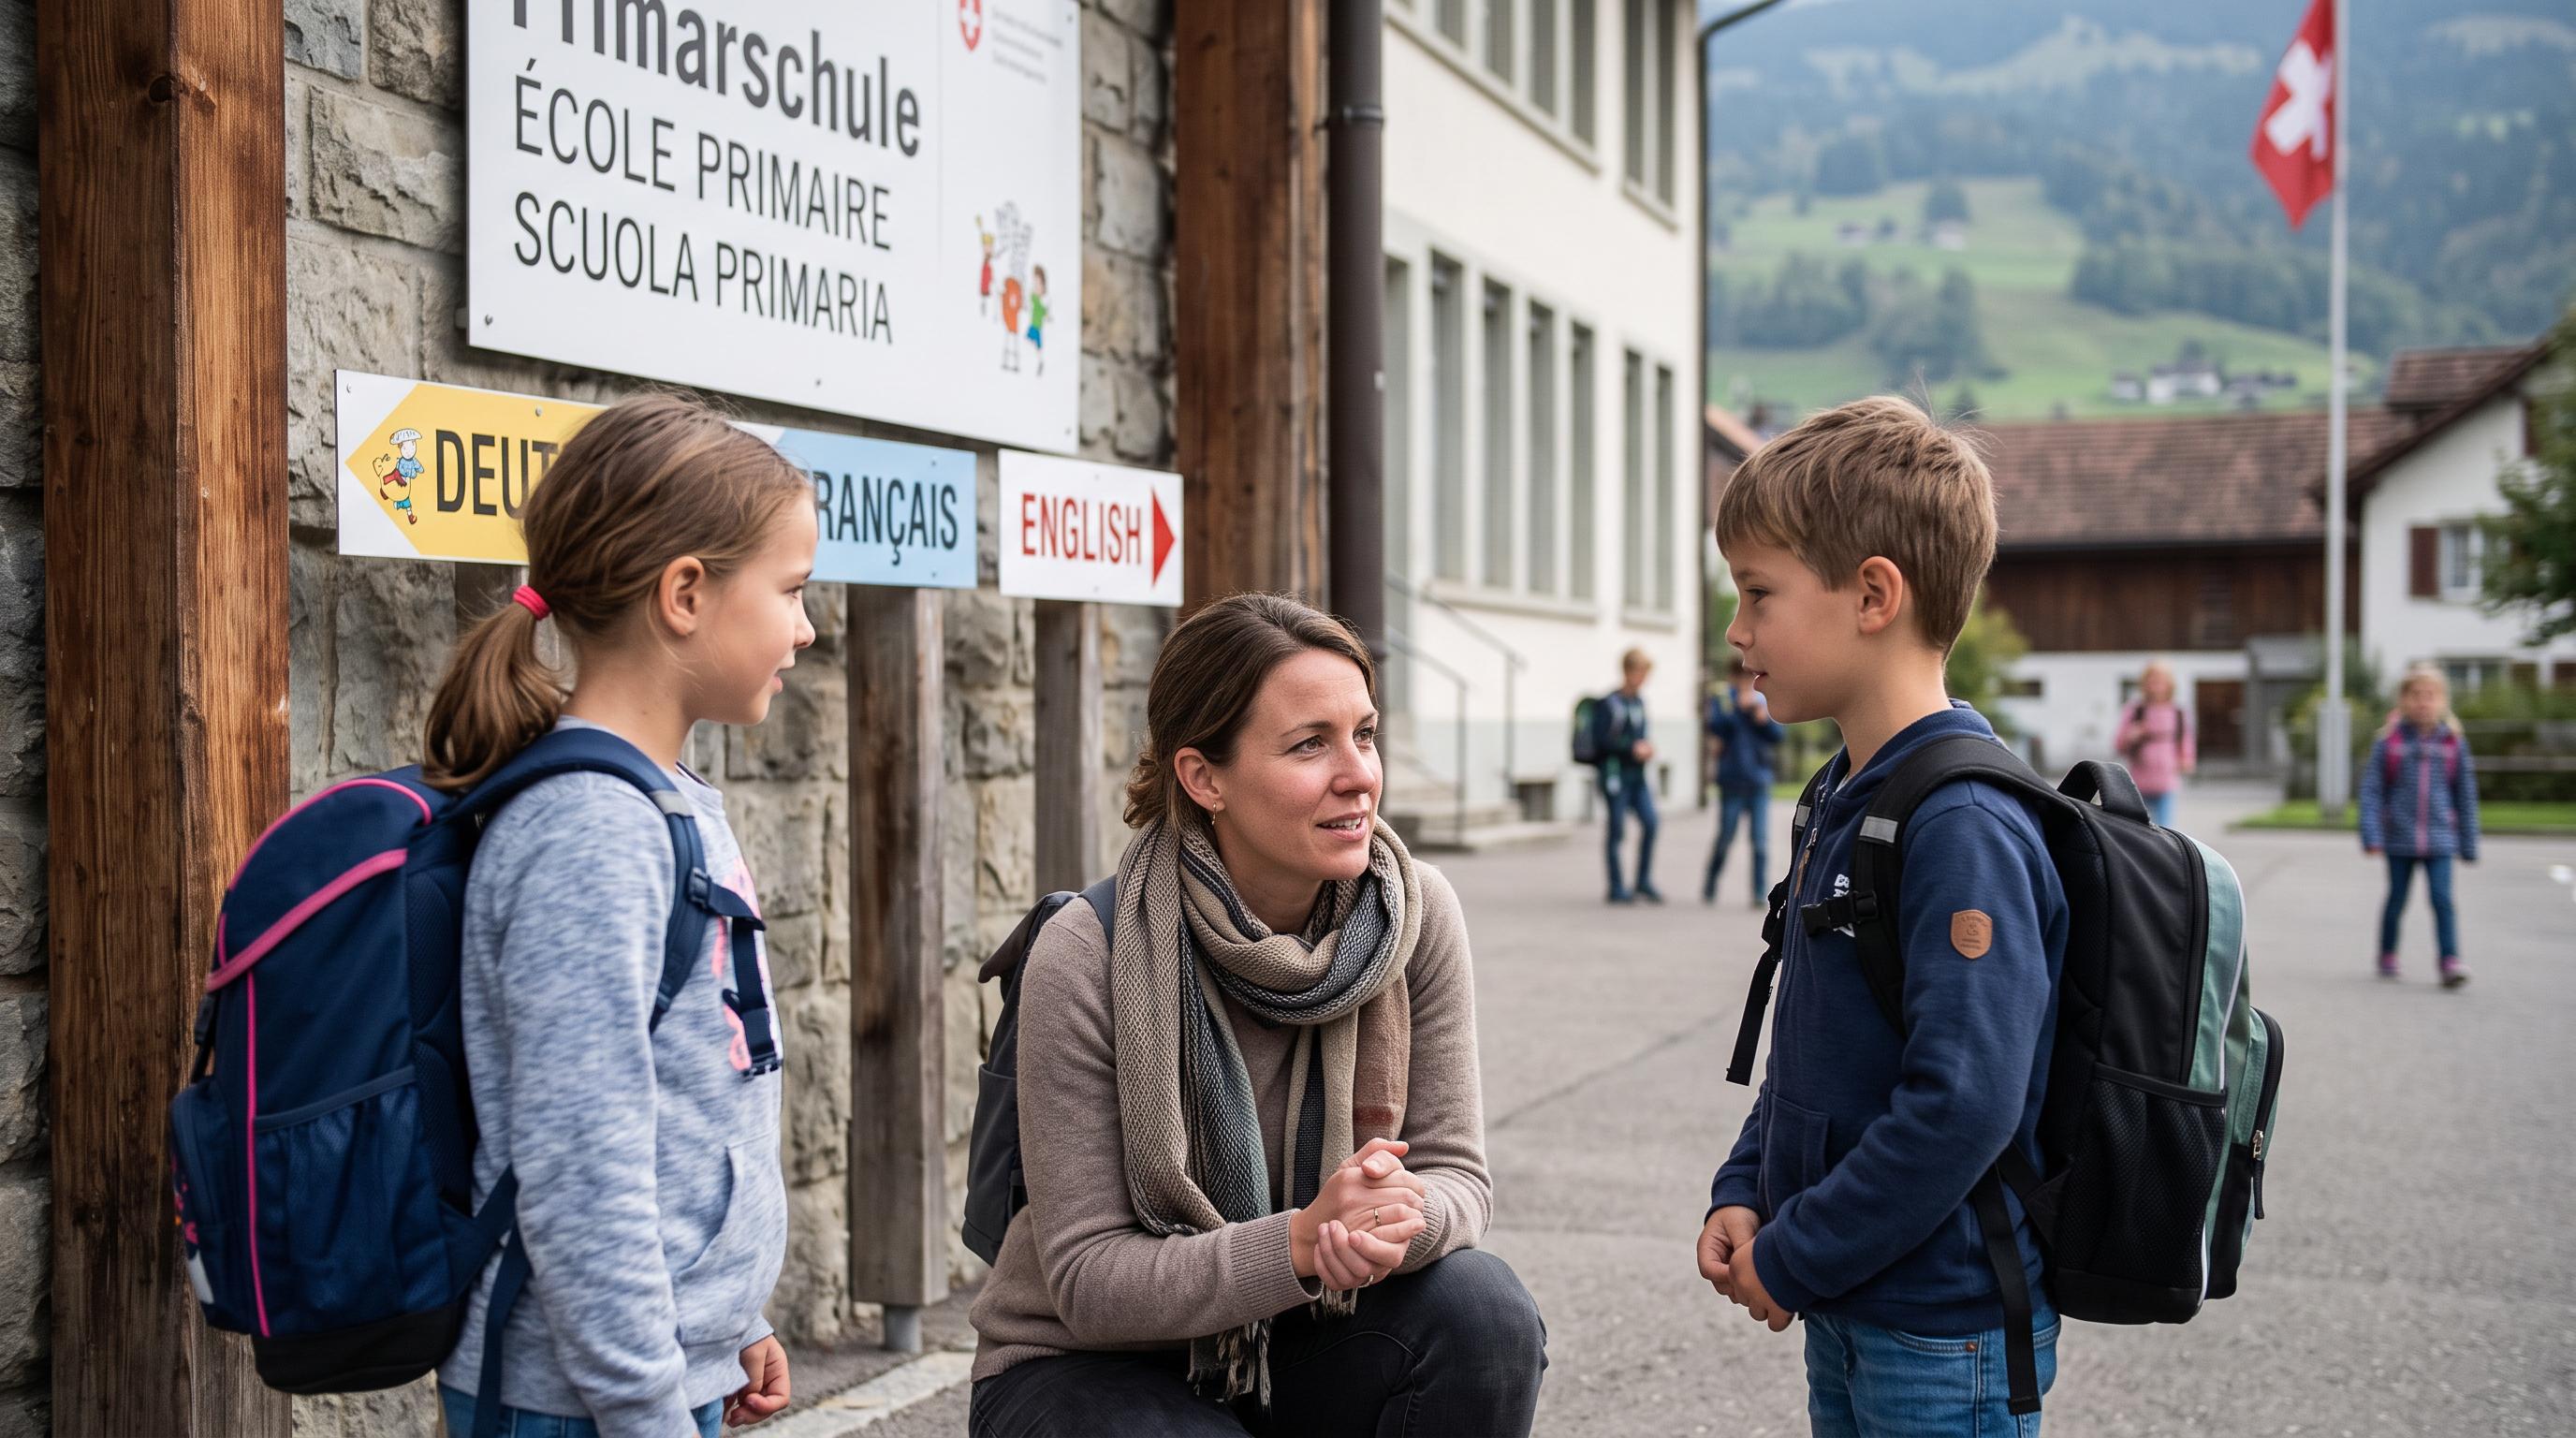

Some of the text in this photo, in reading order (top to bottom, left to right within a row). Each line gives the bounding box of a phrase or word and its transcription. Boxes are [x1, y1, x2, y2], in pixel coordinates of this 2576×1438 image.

[515, 57, 891, 251] ÉCOLE PRIMAIRE
[514, 191, 892, 345] SCUOLA PRIMARIA
[435, 429, 560, 520] DEUT
[812, 470, 959, 566] RANÇAIS
[1021, 492, 1142, 565] ENGLISH
